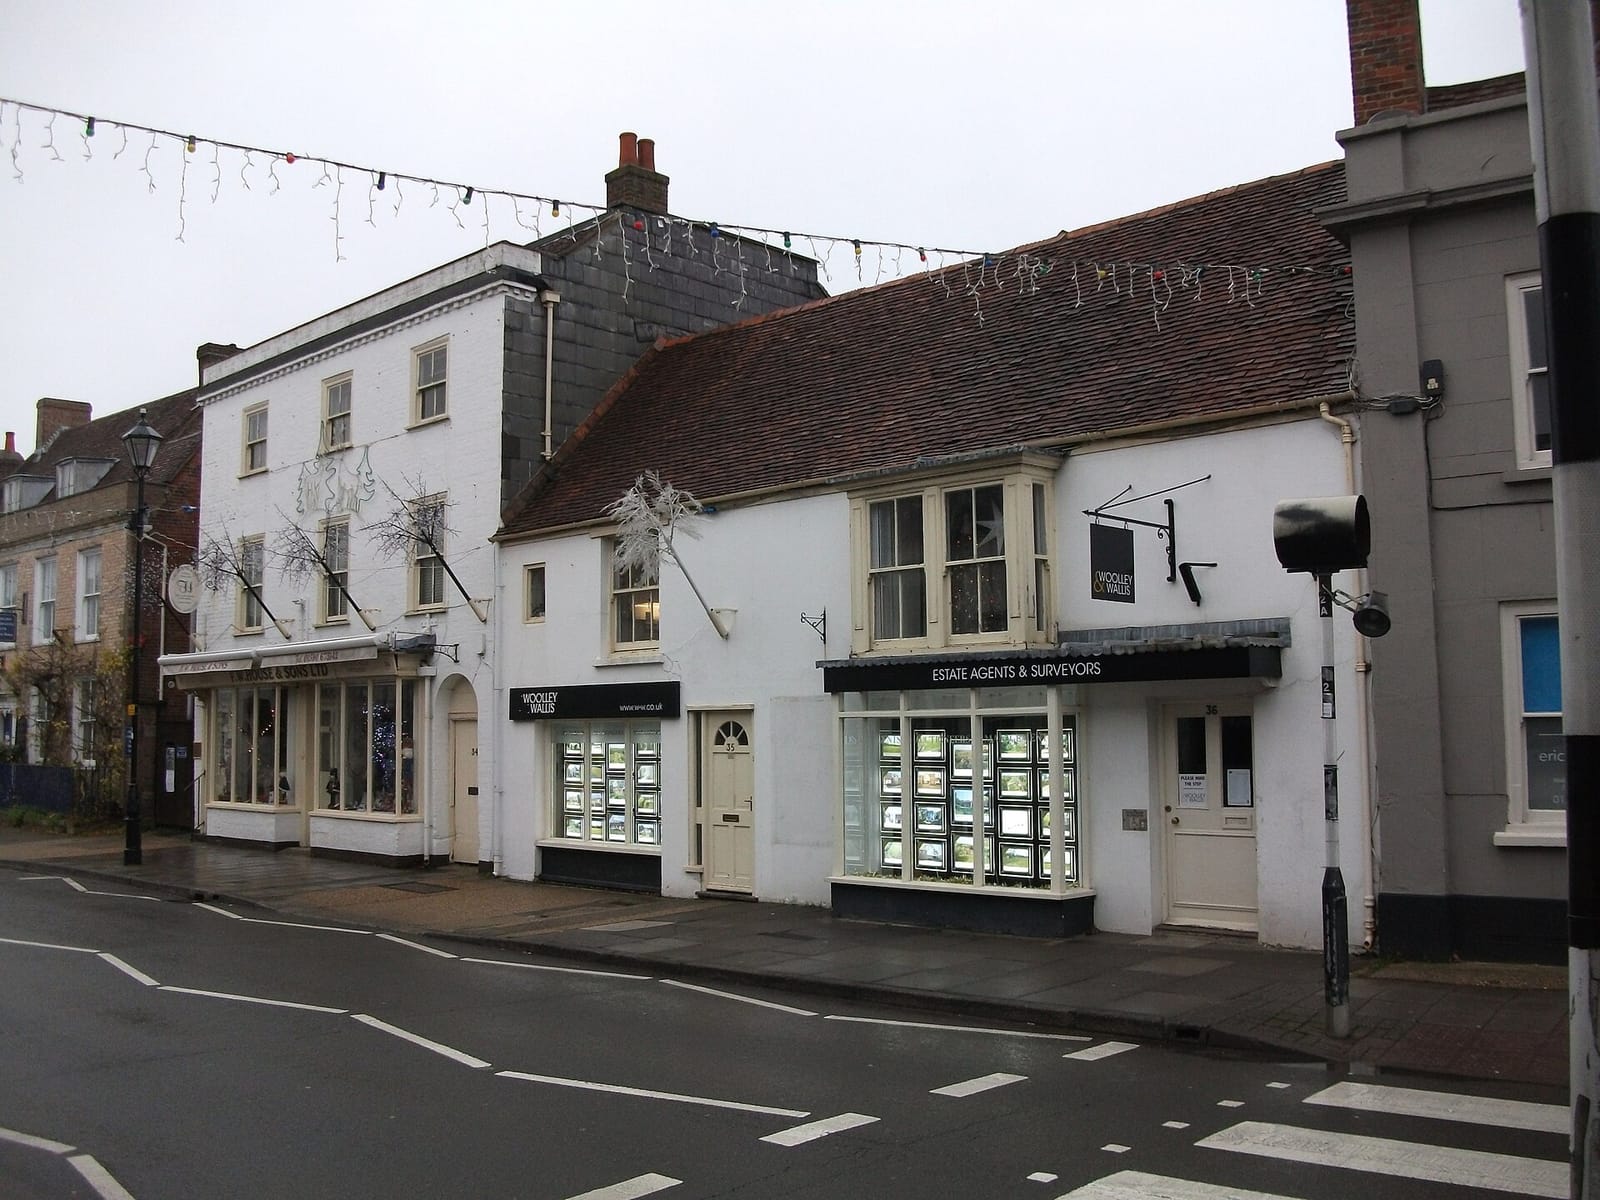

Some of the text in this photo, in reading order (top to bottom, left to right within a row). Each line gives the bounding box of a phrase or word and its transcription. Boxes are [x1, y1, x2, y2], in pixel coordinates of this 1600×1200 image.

[1099, 571, 1132, 585] WOOLLEY
[1106, 583, 1130, 595] WALLIS
[1320, 606, 1328, 616] A
[283, 664, 308, 679] SONS
[310, 664, 329, 677] LTD
[932, 662, 1101, 681] ESTATE AGENTS & SURVEYORS
[1323, 682, 1330, 692] 2
[522, 691, 558, 704] WOOLLEY
[530, 703, 555, 714] WALLIS
[1205, 704, 1218, 715] 36
[726, 743, 735, 751] 35
[1539, 749, 1566, 762] eric
